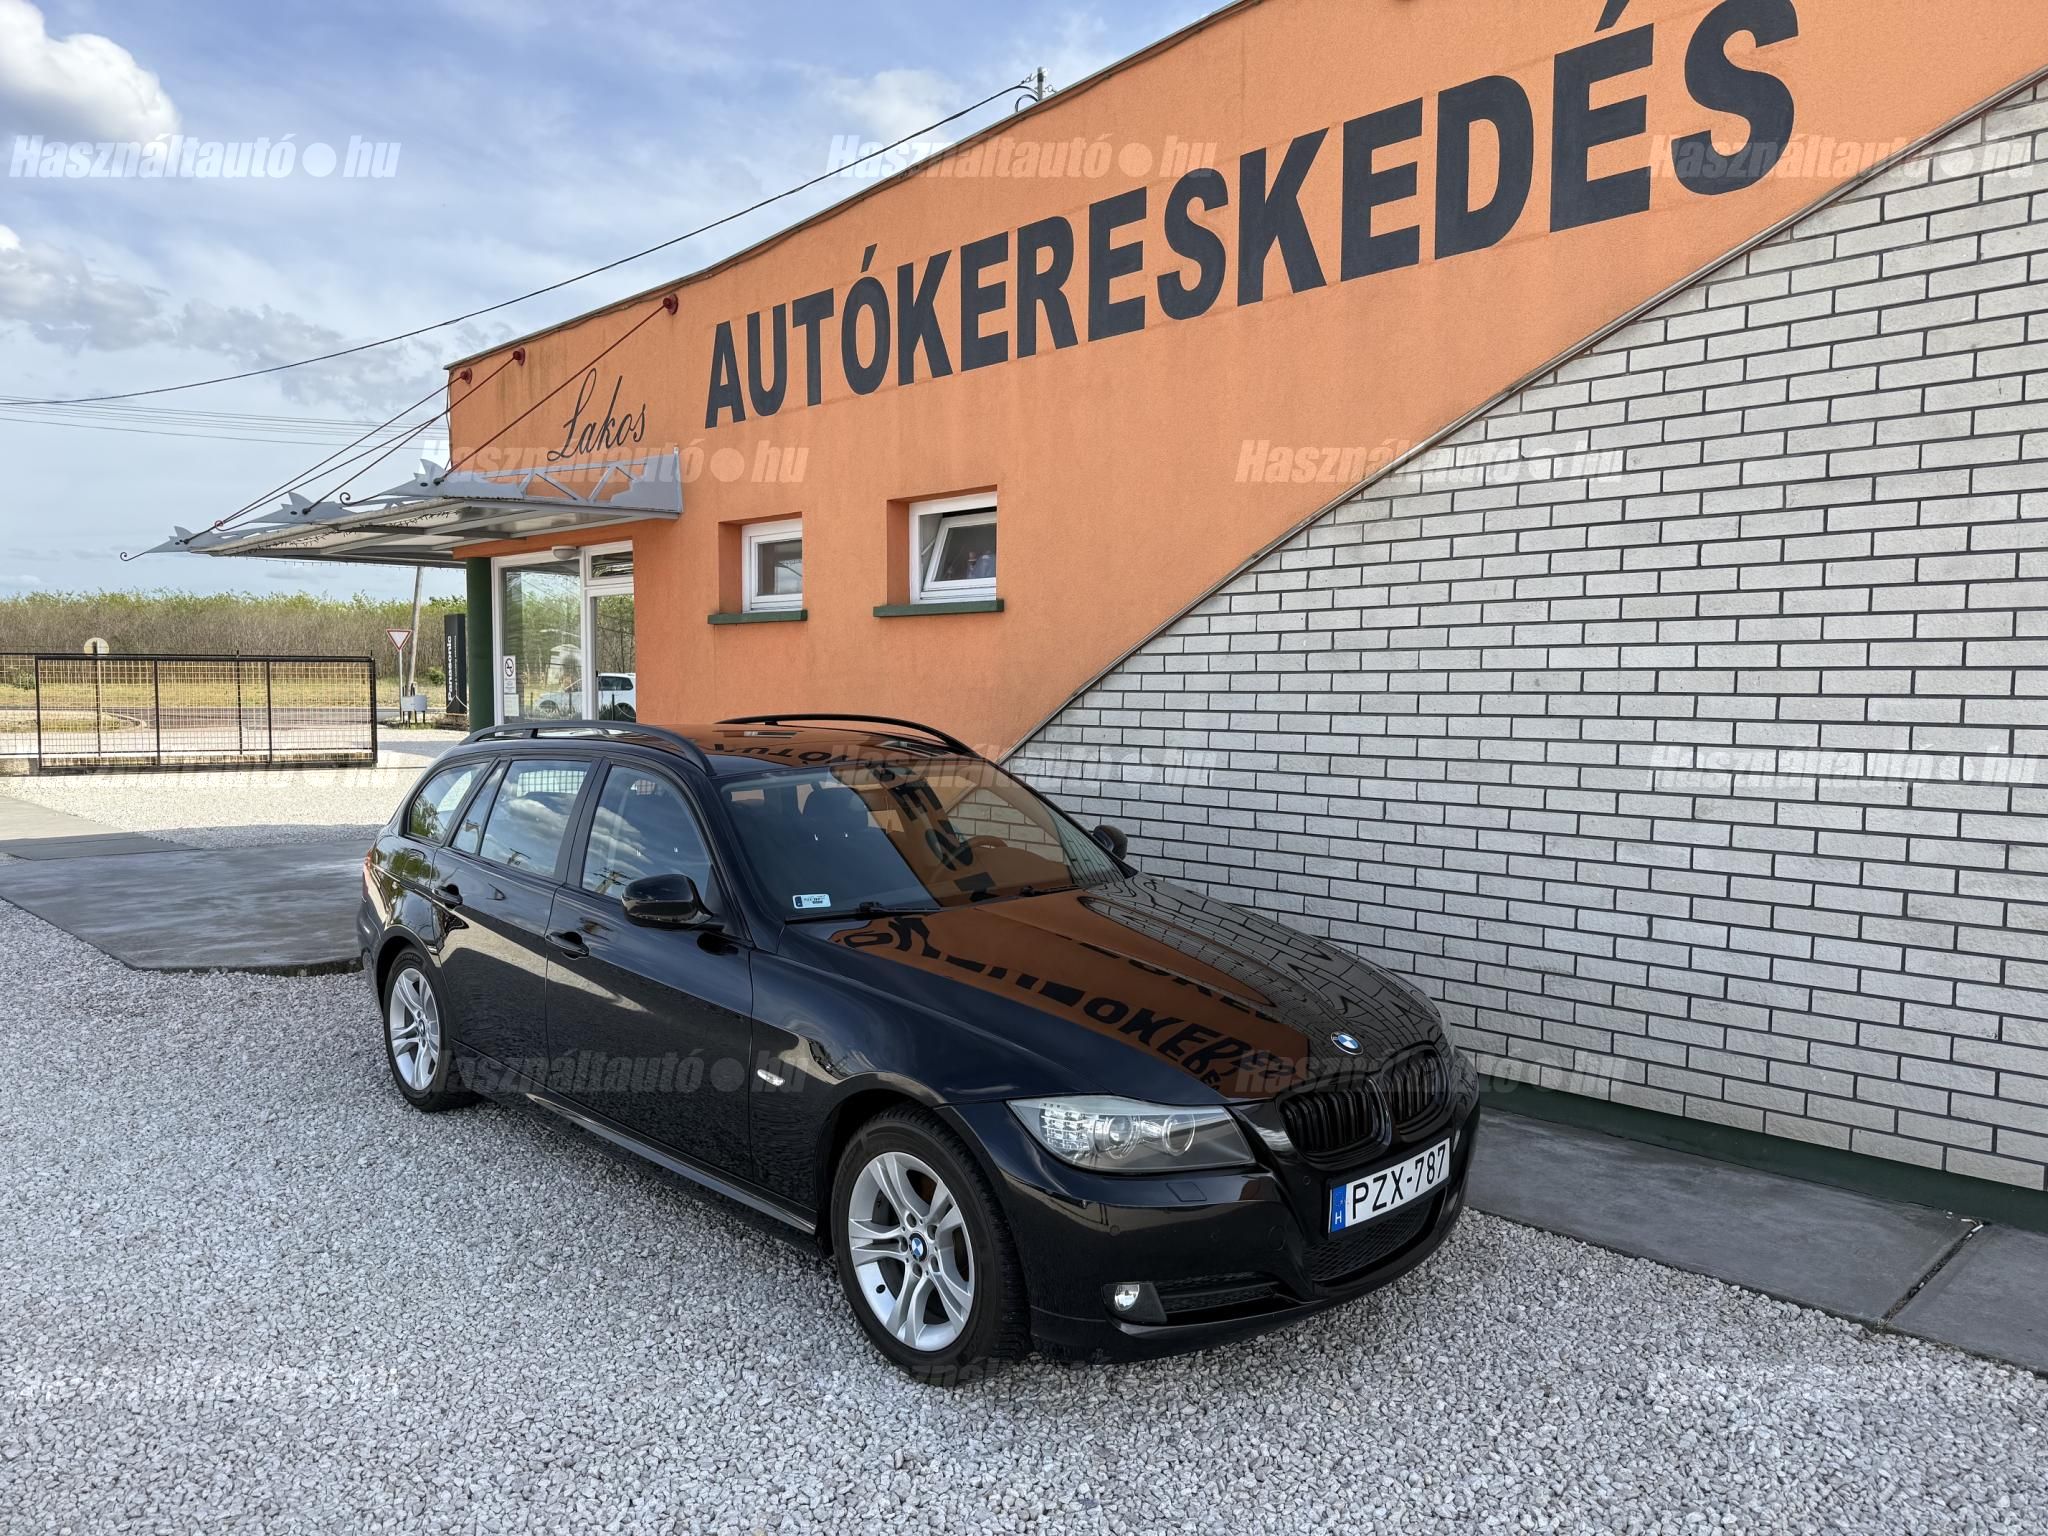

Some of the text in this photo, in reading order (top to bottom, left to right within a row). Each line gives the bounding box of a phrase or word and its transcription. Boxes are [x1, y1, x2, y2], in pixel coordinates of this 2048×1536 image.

[704, 0, 1799, 429] AUTÓKERESKEDÉS
[547, 367, 646, 462] Lakos
[1334, 1210, 1343, 1225] H
[1352, 1144, 1446, 1220] PZX-787
